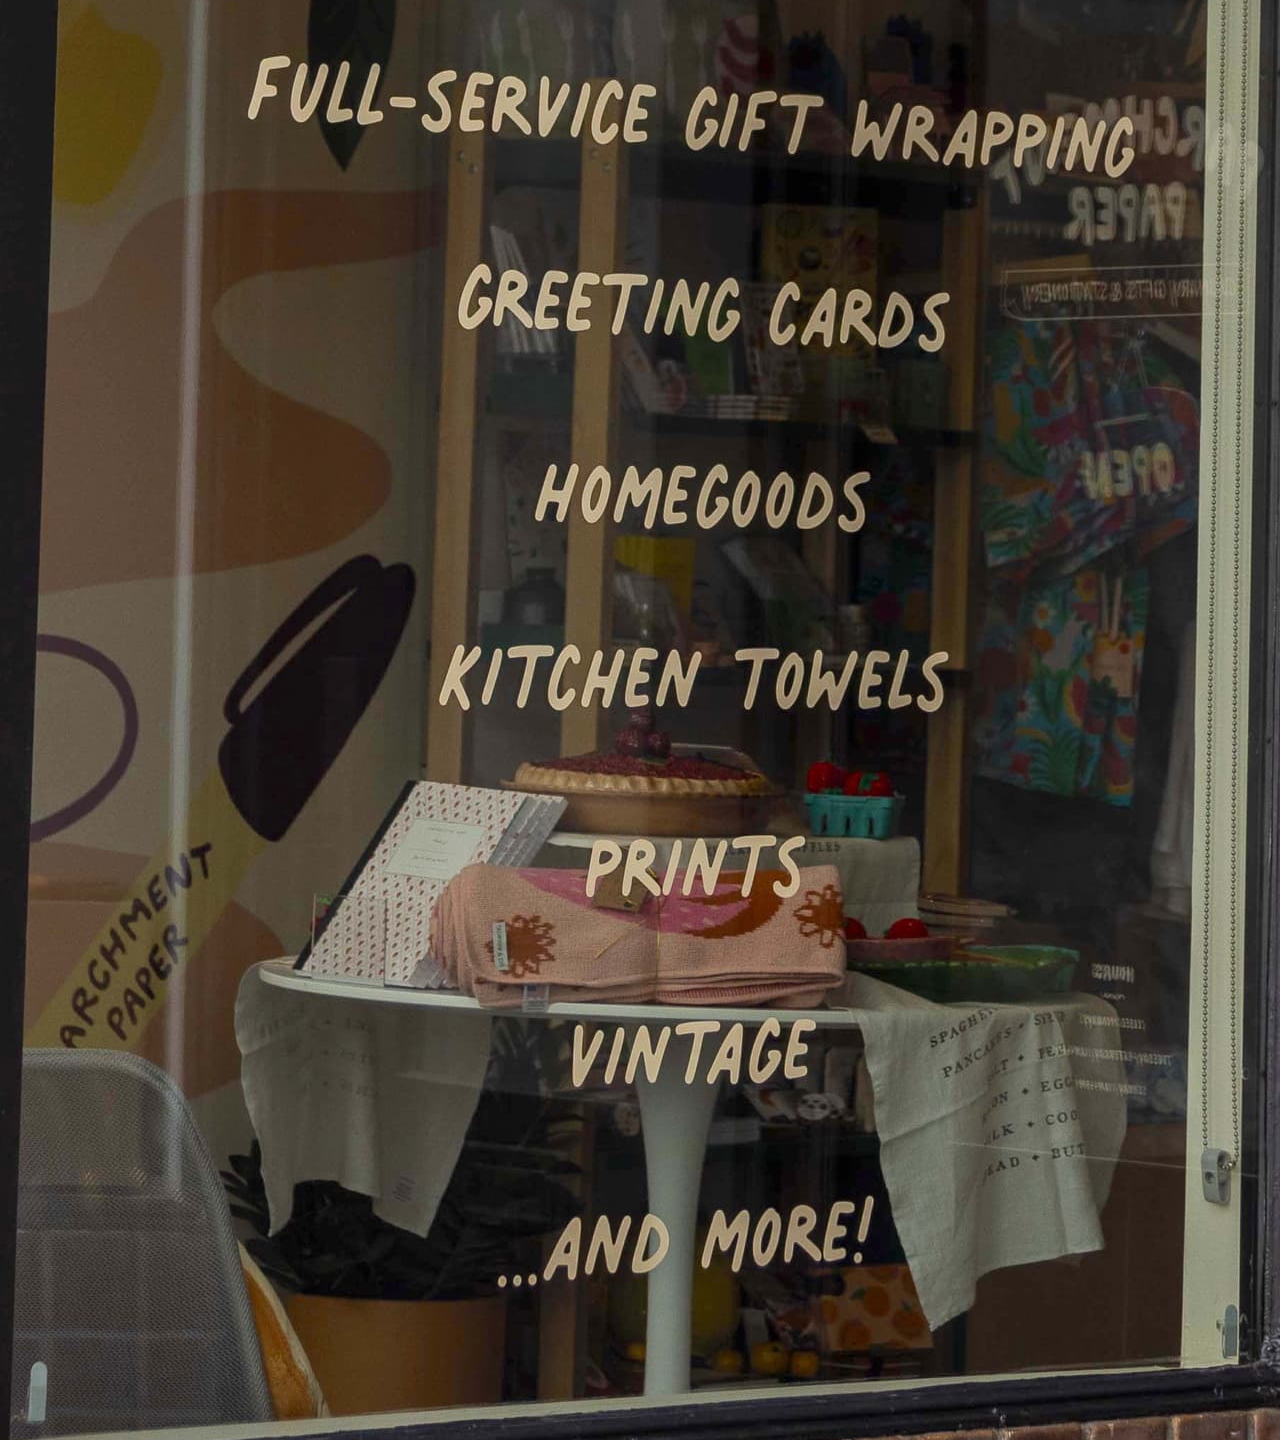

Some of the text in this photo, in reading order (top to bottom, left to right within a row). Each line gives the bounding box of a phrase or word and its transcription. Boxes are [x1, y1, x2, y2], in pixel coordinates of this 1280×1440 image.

[248, 56, 1134, 177] FULL-SERVICE GIFT WRAPPING
[459, 264, 949, 352] GREETING CARDS
[535, 464, 869, 532] HOMEGOODS
[439, 645, 948, 712] KITCHEN TOWELS
[587, 835, 805, 898] PRINTS
[60, 842, 212, 1048] ARCHMENT
[107, 924, 188, 1041] PAPER
[570, 1020, 816, 1087] VINTAGE
[498, 1196, 873, 1286] ...AND MORE!
